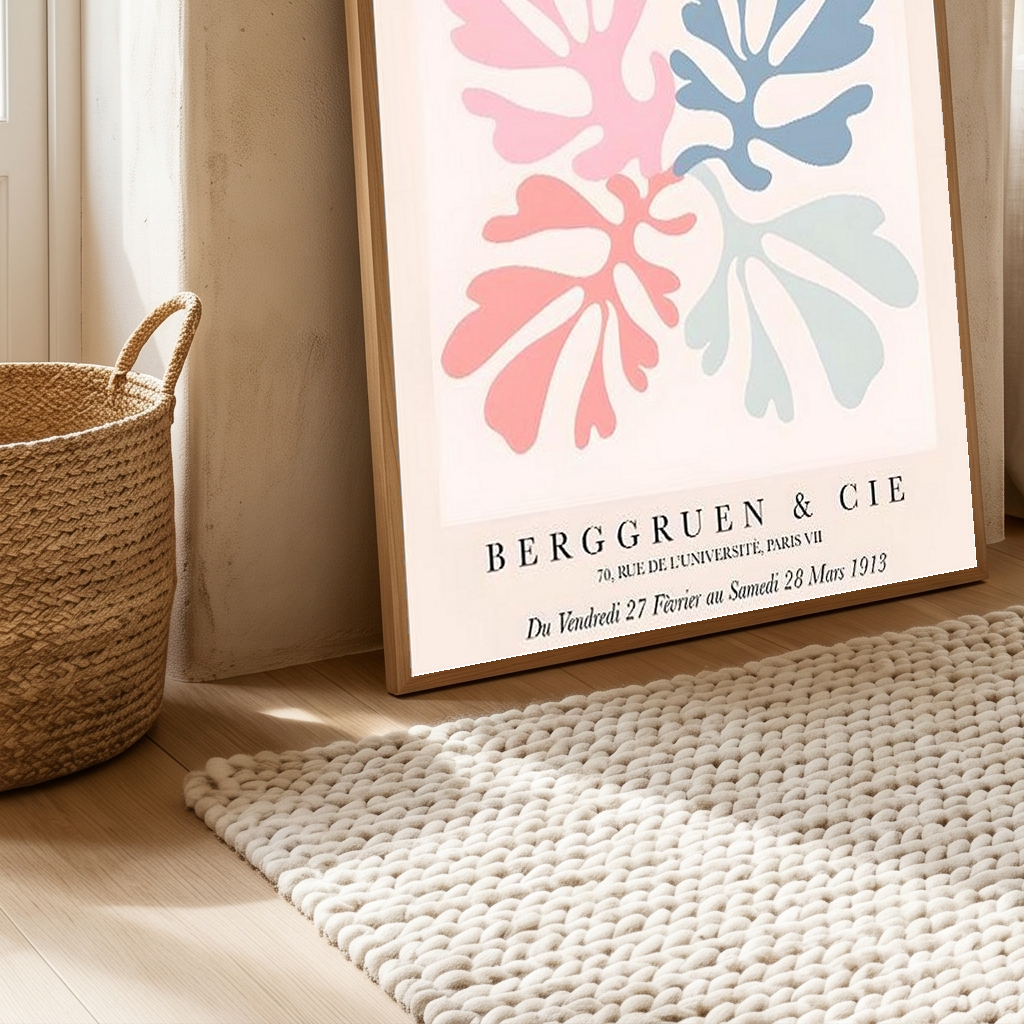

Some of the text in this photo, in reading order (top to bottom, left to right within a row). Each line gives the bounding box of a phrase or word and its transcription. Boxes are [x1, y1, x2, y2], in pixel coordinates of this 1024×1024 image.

[485, 475, 906, 573] BERGGRUEN & CIE
[597, 568, 615, 584] 70,
[618, 562, 645, 579] RUE
[649, 558, 668, 574] DE
[767, 534, 802, 553] PARIS
[804, 530, 822, 545] VII
[526, 616, 551, 640] Du
[559, 601, 621, 634] Vendredi
[626, 598, 646, 621] 27
[706, 589, 724, 606] au
[728, 572, 779, 601] Samedi
[784, 568, 804, 590] 28
[808, 563, 845, 586] Mars
[851, 552, 887, 578] 1913
